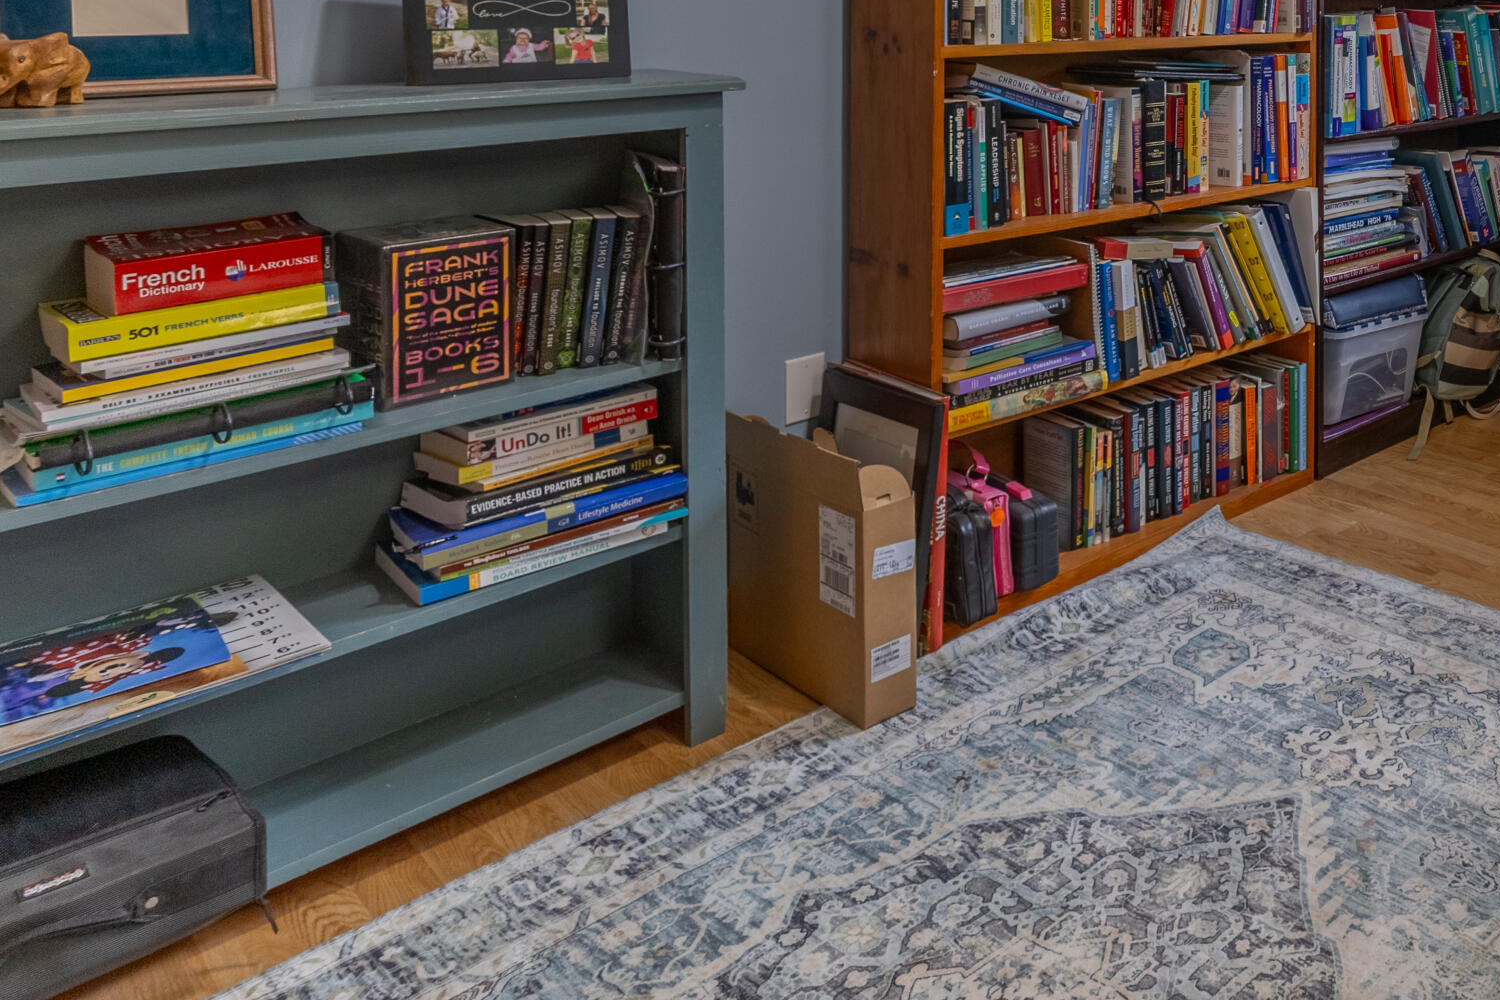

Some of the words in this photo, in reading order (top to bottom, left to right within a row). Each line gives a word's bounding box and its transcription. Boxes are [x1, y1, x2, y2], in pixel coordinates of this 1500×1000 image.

[998, 75, 1030, 91] CHRONIC
[1032, 86, 1047, 98] PAIN
[1048, 91, 1070, 103] RESET
[956, 108, 964, 131] Signs
[955, 139, 964, 182] Symptoms
[991, 137, 999, 187] LEADERSHIP
[1472, 176, 1486, 217] CURRENT
[1328, 218, 1365, 233] MARBLEHEAD
[1367, 216, 1381, 225] HIGH
[249, 254, 319, 273] LAROUSSE
[404, 250, 499, 278] FRANK
[520, 241, 530, 278] ASIMOV
[533, 241, 545, 278] ASIMOV
[554, 238, 564, 274] ASIMOV
[573, 233, 584, 268] ASIMOV
[597, 233, 608, 269] ASIMOV
[623, 230, 634, 267] ASIMOV
[121, 264, 206, 291] French
[139, 280, 206, 298] Dictionary
[404, 266, 500, 290] HERBERT'S
[404, 278, 499, 310] DUNE
[1105, 266, 1113, 301] Upstream
[404, 299, 499, 332] SAGA
[514, 286, 526, 322] foundation
[128, 324, 160, 341] 501
[164, 318, 209, 332] FRENCH
[210, 311, 244, 325] VERBS
[528, 313, 538, 352] foundation
[588, 311, 599, 348] foundation
[611, 309, 622, 347] foundation
[404, 336, 500, 366] BOOKS
[990, 369, 1017, 382] Palliative
[1018, 365, 1031, 376] Care
[1032, 358, 1062, 370] Consultant
[587, 412, 604, 424] Dean
[605, 409, 626, 420] Ornish
[1191, 391, 1199, 412] Killing
[501, 430, 550, 453] UnDo
[555, 423, 572, 440] It!
[599, 419, 615, 429] Anne
[616, 414, 637, 425] Ornish
[1191, 412, 1199, 433] Patton
[96, 462, 113, 474] THE
[119, 450, 168, 470] COMPLETE
[262, 422, 295, 438] COURSE
[471, 488, 542, 515] EVIDENCE-BASED
[544, 478, 582, 495] PRACTICE
[584, 473, 594, 484] IN
[595, 465, 626, 481] ACTION
[578, 506, 609, 521] Lifestyle
[610, 495, 643, 514] Medicine
[935, 495, 946, 542] CHINA
[492, 566, 528, 583] BOARD
[529, 555, 568, 572] REVIEW
[570, 542, 610, 558] MANUAL
